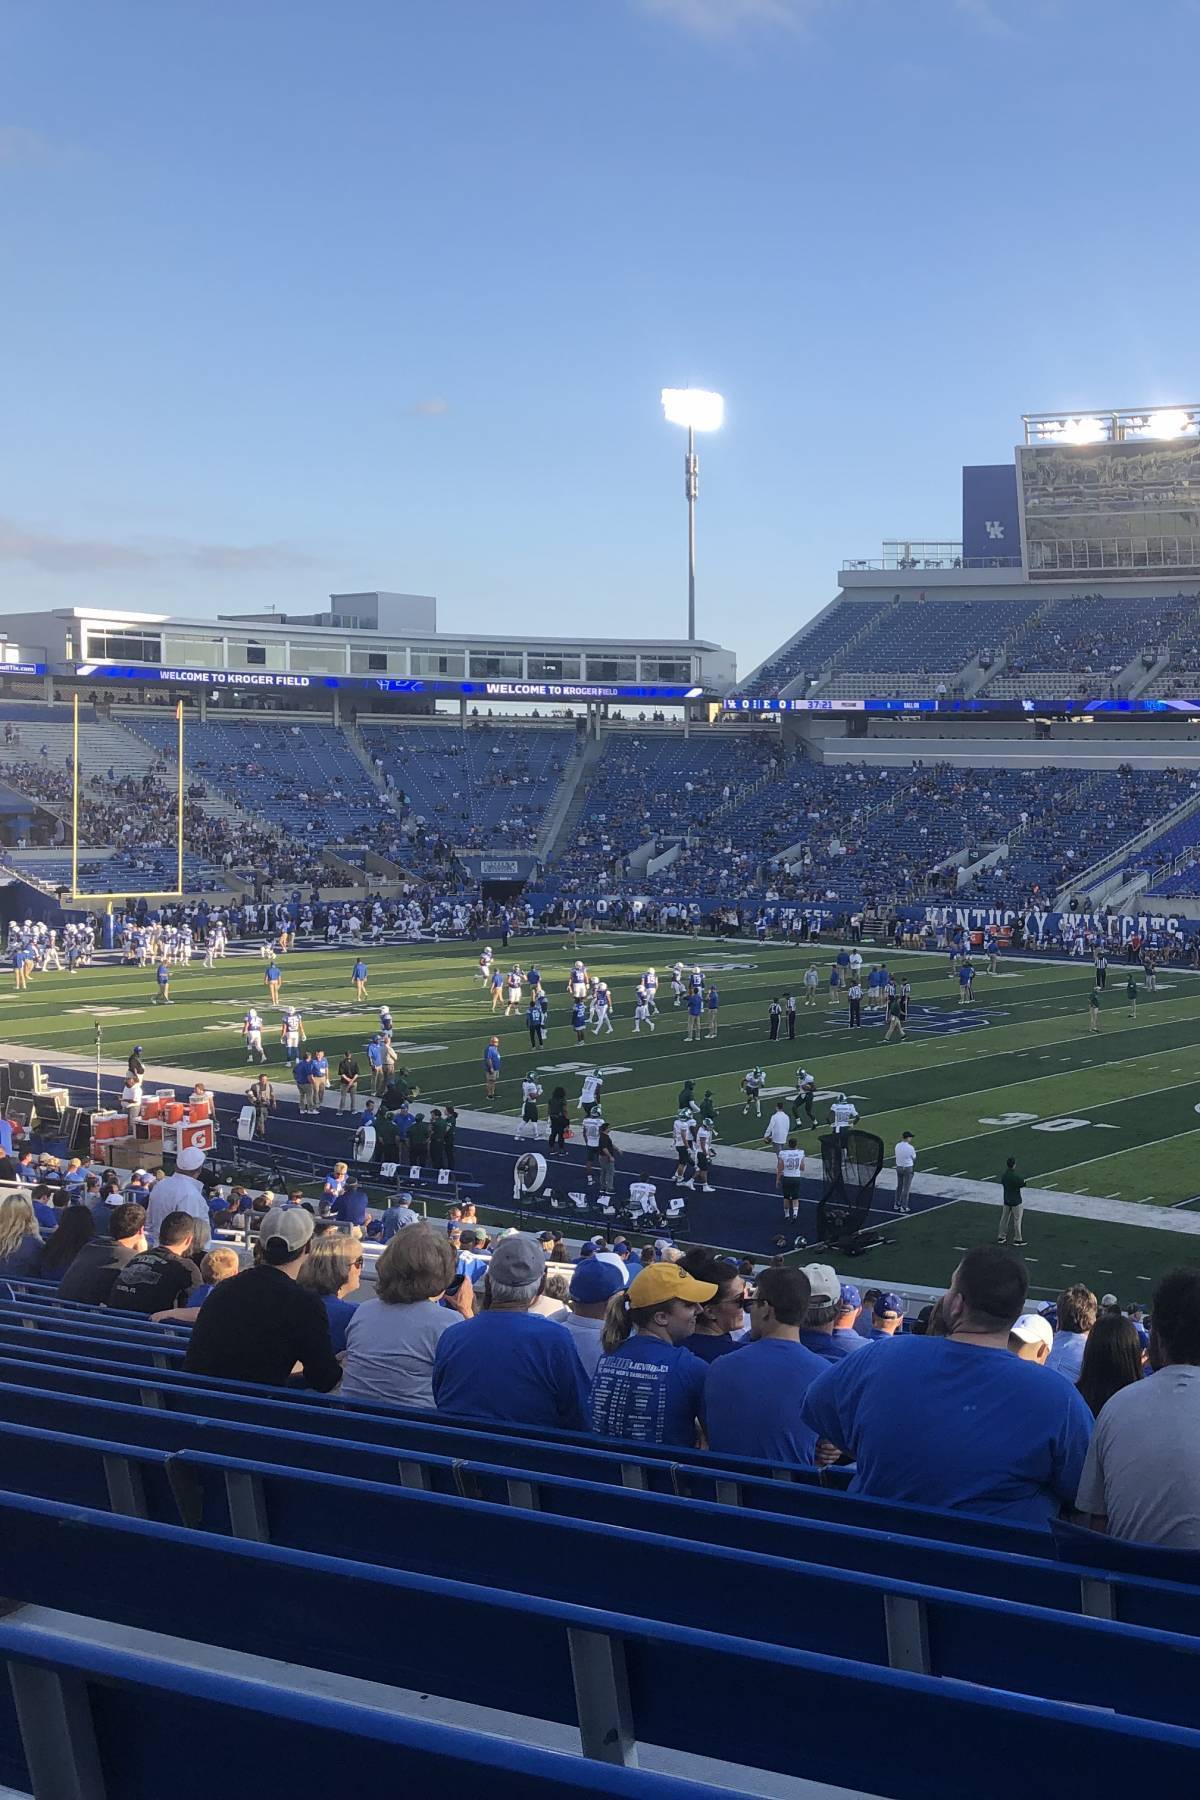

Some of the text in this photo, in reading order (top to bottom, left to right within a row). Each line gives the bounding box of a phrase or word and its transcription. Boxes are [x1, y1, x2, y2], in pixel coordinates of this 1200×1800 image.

[160, 670, 310, 687] WELCOME TO KROGER FIELD
[486, 683, 618, 696] WELCOME TO KROGER FIELD
[978, 1112, 1092, 1132] 30
[191, 1130, 206, 1148] G
